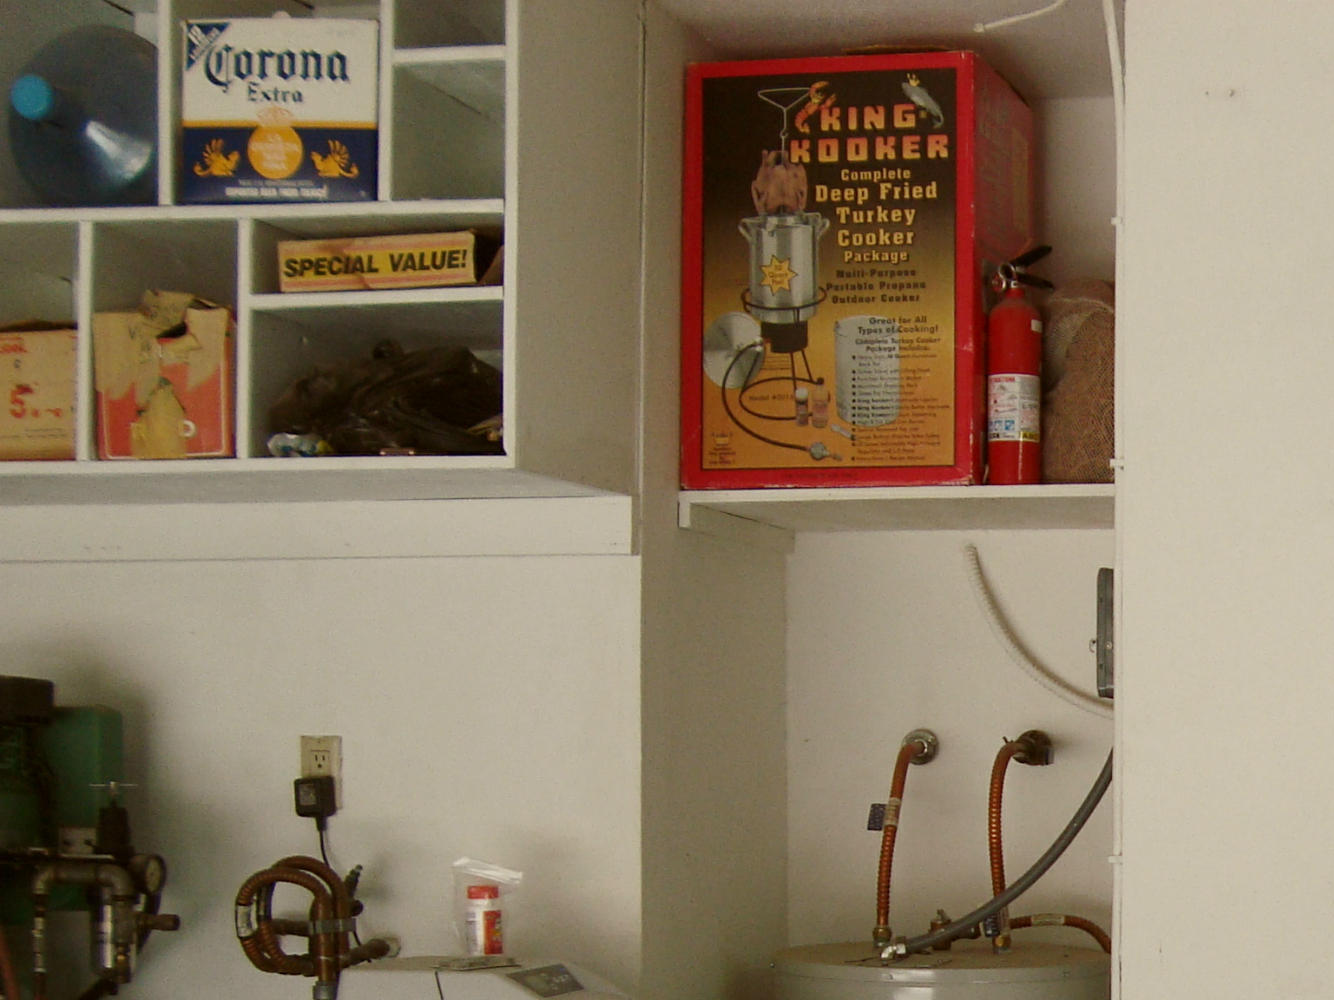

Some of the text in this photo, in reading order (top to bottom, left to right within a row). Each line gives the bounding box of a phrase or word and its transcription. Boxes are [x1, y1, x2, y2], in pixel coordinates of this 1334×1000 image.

[205, 44, 349, 93] Corona
[248, 81, 303, 103] Extra
[820, 103, 917, 132] KING
[790, 134, 949, 163] KOOKER
[841, 167, 912, 183] Complete
[815, 181, 938, 205] Deep Fried
[836, 205, 916, 226] Turkey
[838, 229, 915, 247] Cooker
[283, 249, 467, 278] SPECIAL VALUE!
[844, 250, 909, 264] Package
